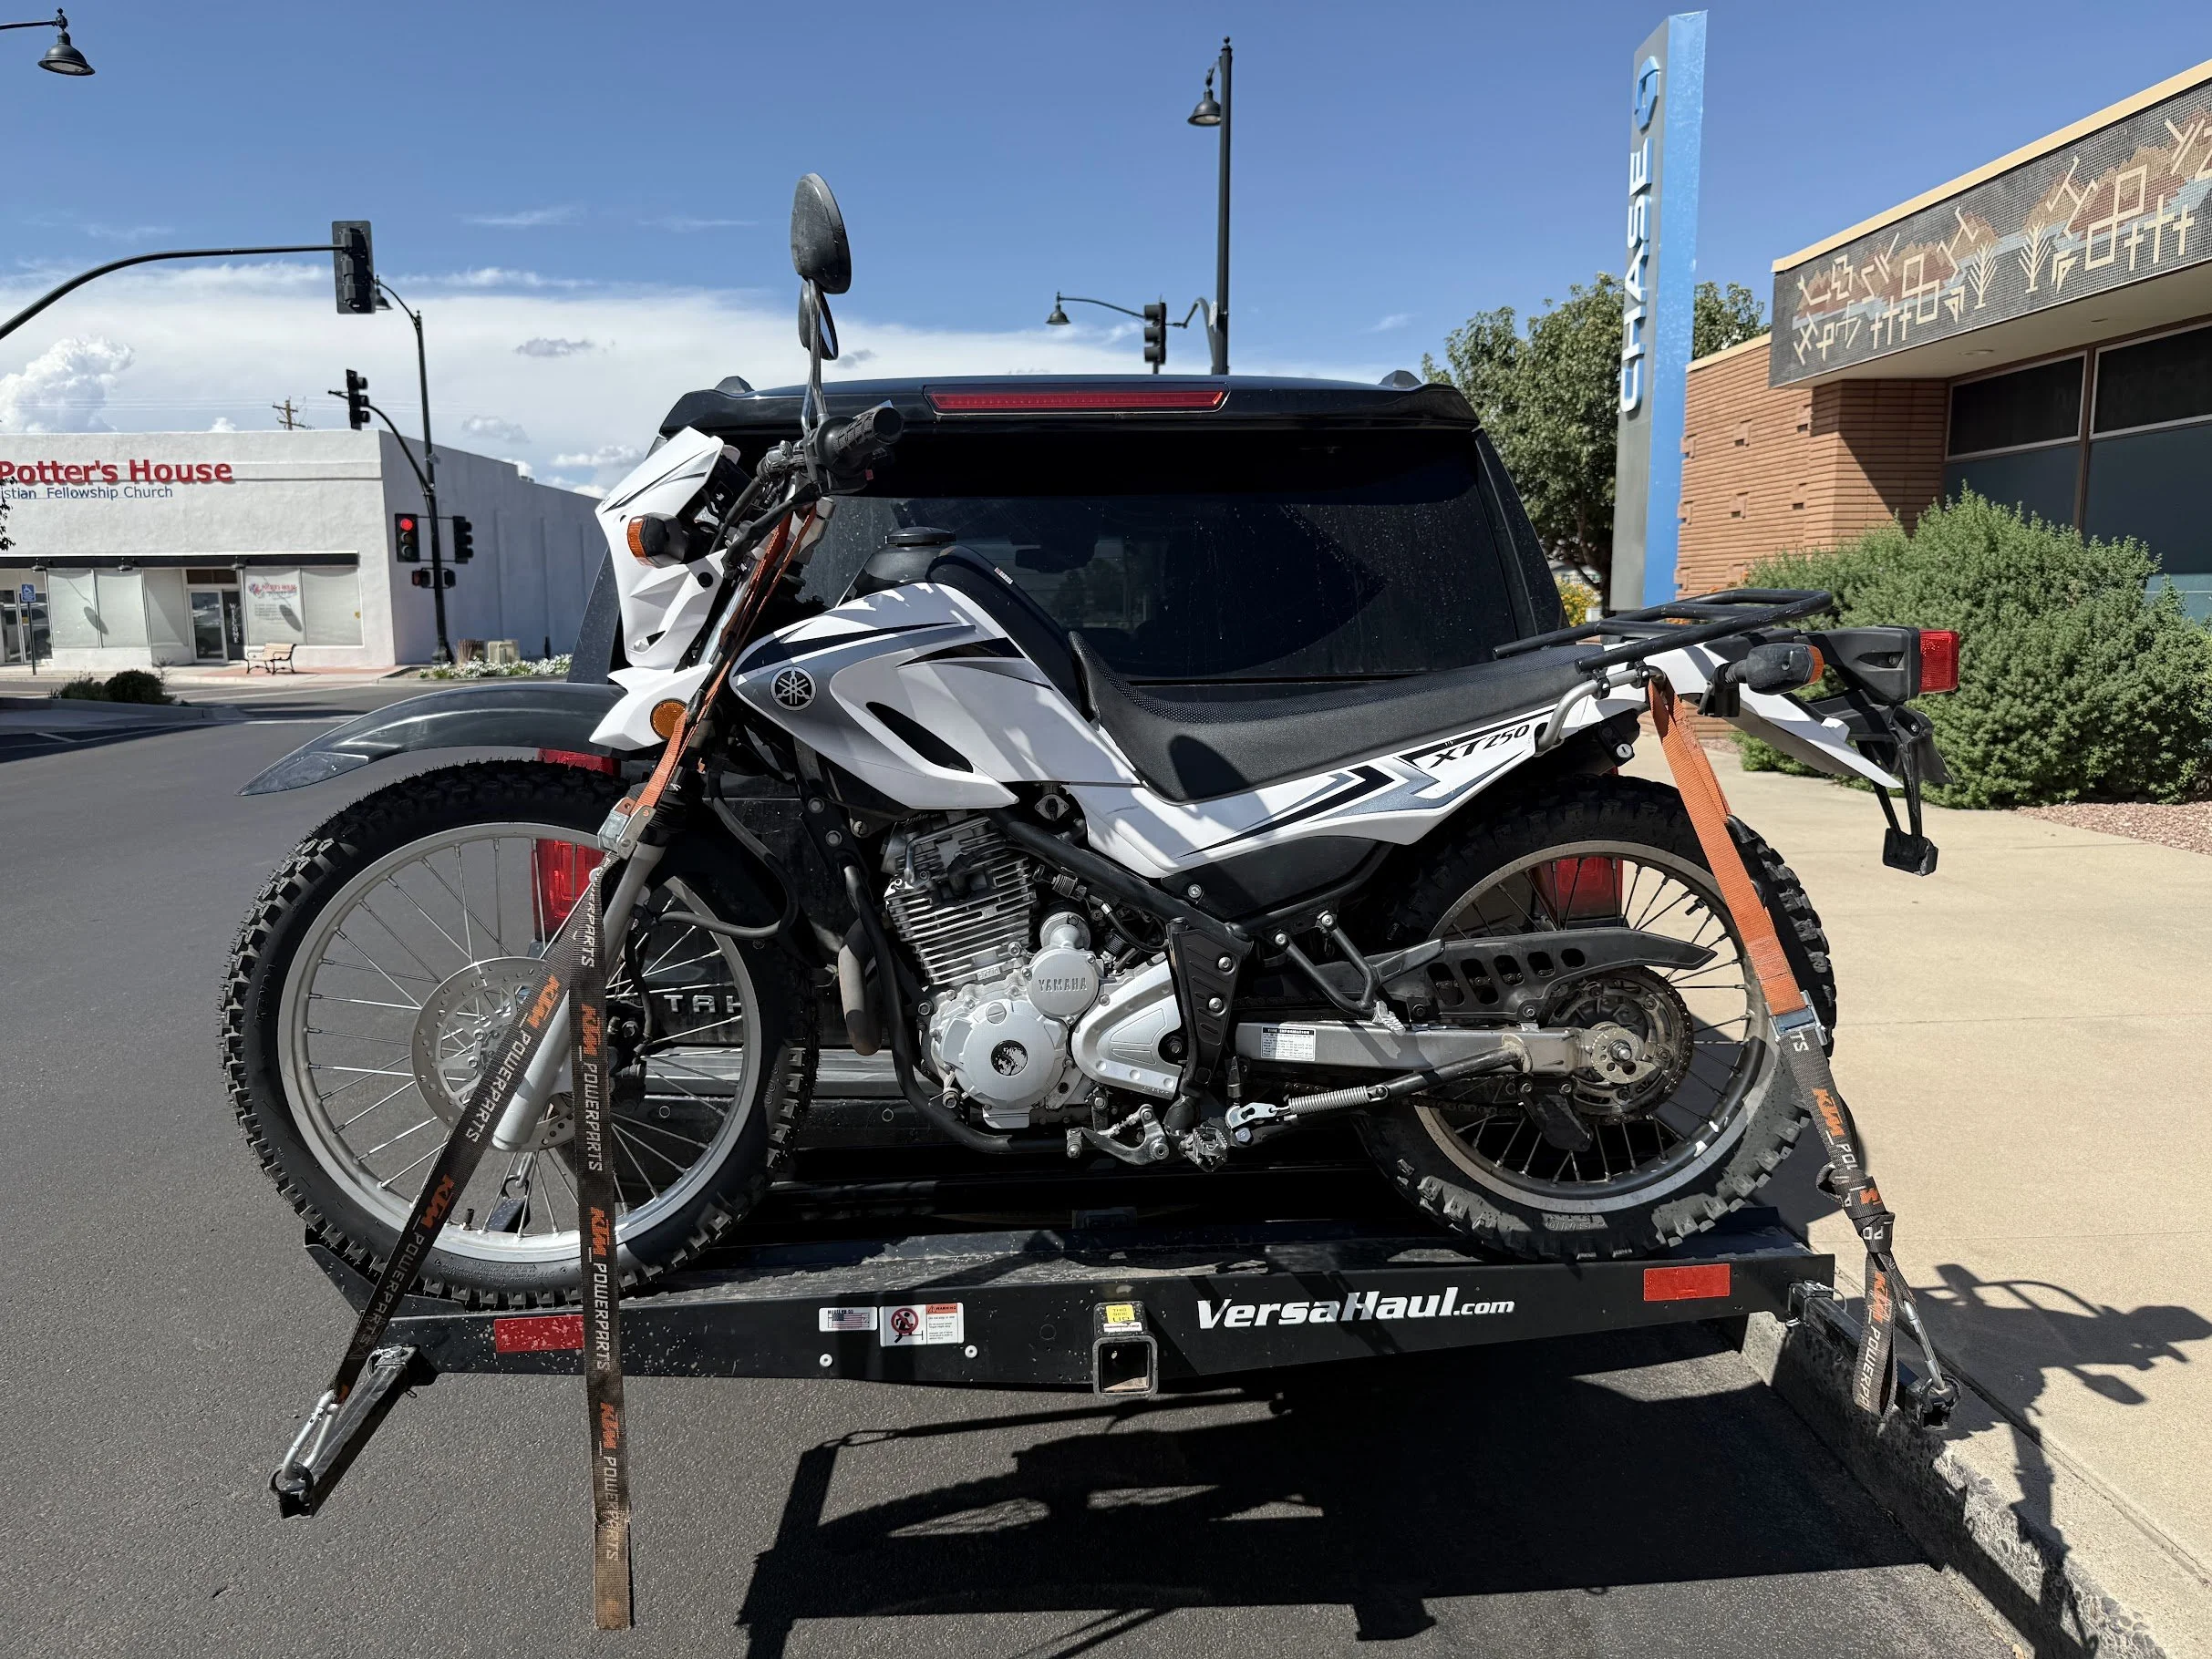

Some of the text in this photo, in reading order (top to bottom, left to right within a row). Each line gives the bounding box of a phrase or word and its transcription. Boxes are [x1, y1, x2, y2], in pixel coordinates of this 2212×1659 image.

[1619, 138, 1653, 413] CHASE
[0, 459, 233, 484] Potter's House
[47, 486, 119, 500] Fellowship
[123, 485, 173, 499] Church
[1427, 724, 1531, 769] XT250
[1038, 976, 1088, 993] YAMAHA
[465, 974, 561, 1143] KTM POWERPARTS
[581, 1004, 603, 1172] KTM POWERPARTS
[1812, 1087, 1845, 1138] KTM
[421, 1173, 455, 1230] KTM
[590, 1206, 611, 1370] KTM POWERPARTS
[1196, 1286, 1515, 1330] VersaHaul.com
[1858, 1325, 1882, 1412] POWERPA
[600, 1402, 620, 1561] KTM POWERPARTS
